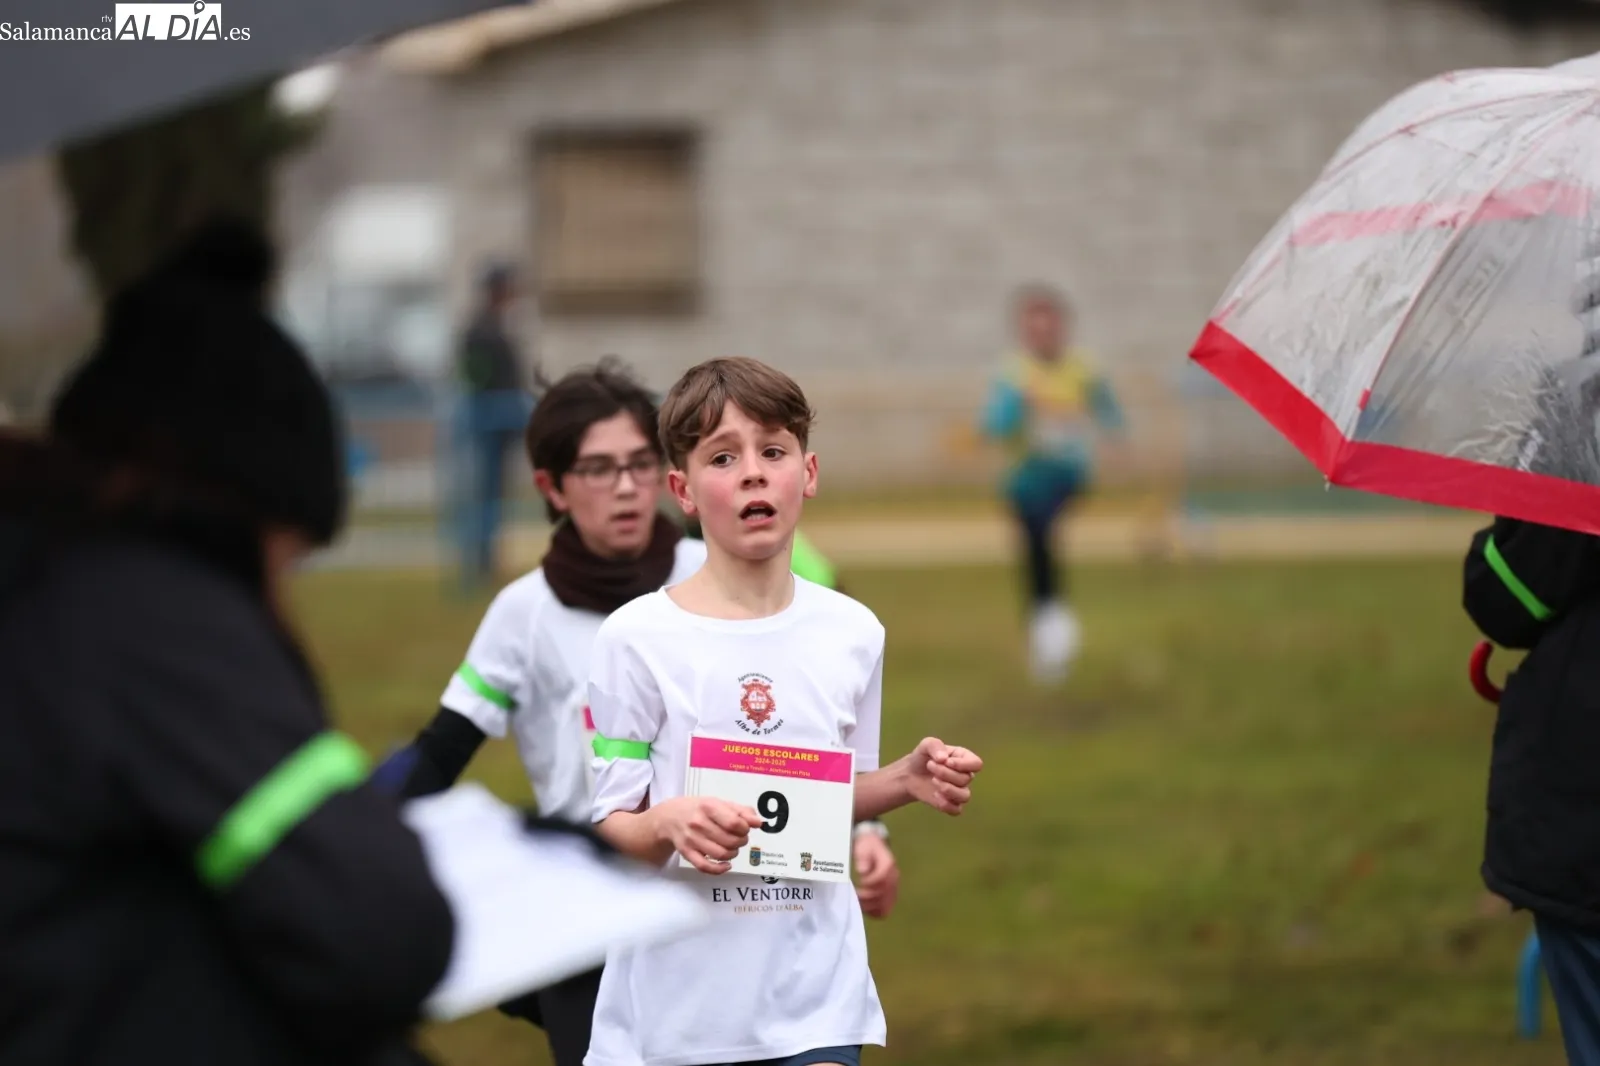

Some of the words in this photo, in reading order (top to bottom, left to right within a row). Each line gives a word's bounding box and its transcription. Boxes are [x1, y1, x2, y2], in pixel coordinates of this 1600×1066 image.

[734, 719, 751, 733] Alba
[751, 728, 761, 736] de
[722, 744, 761, 756] JUEGOS
[763, 748, 820, 762] ESCOLARES
[754, 757, 786, 767] 2024-2025
[757, 790, 789, 834] 9
[813, 859, 844, 868] Ayuntamiento
[819, 866, 844, 874] Salamanca
[712, 887, 731, 902] EL
